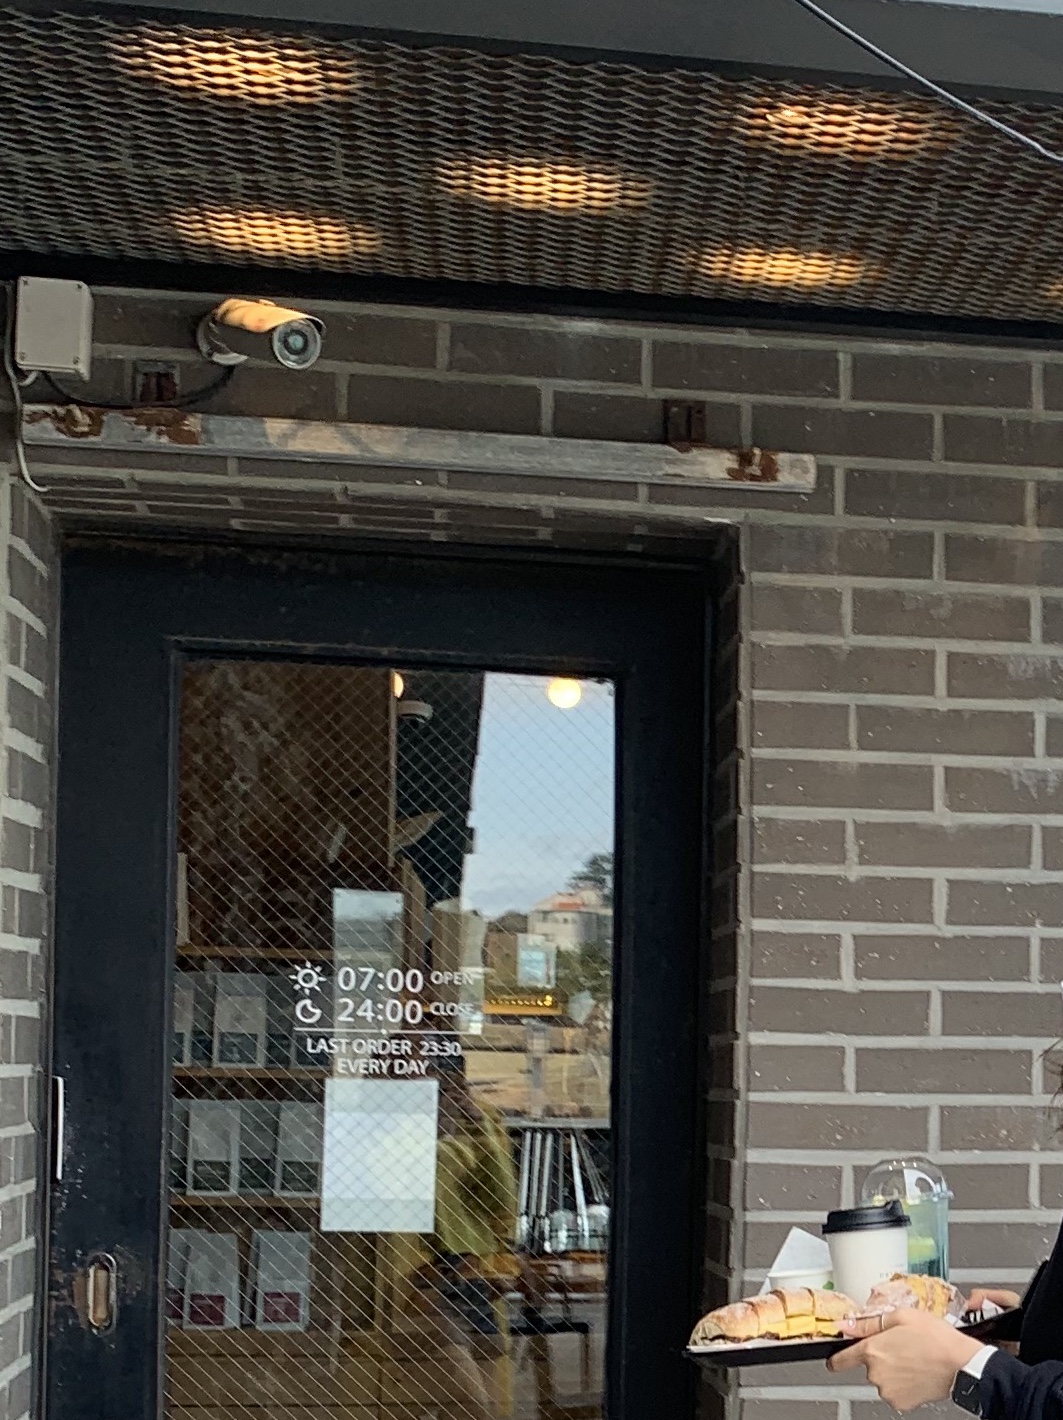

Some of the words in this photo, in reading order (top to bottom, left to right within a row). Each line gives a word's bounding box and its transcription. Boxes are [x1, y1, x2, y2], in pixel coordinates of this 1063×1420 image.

[337, 966, 424, 993] 07:00
[430, 970, 475, 986] OPEN
[337, 999, 423, 1025] 24:00
[430, 1001, 475, 1017] CLOSE
[306, 1037, 348, 1054] LAST
[351, 1038, 412, 1056] ORDER
[419, 1040, 462, 1057] 23:30
[337, 1058, 391, 1074] EVERY
[393, 1059, 429, 1075] DAY
